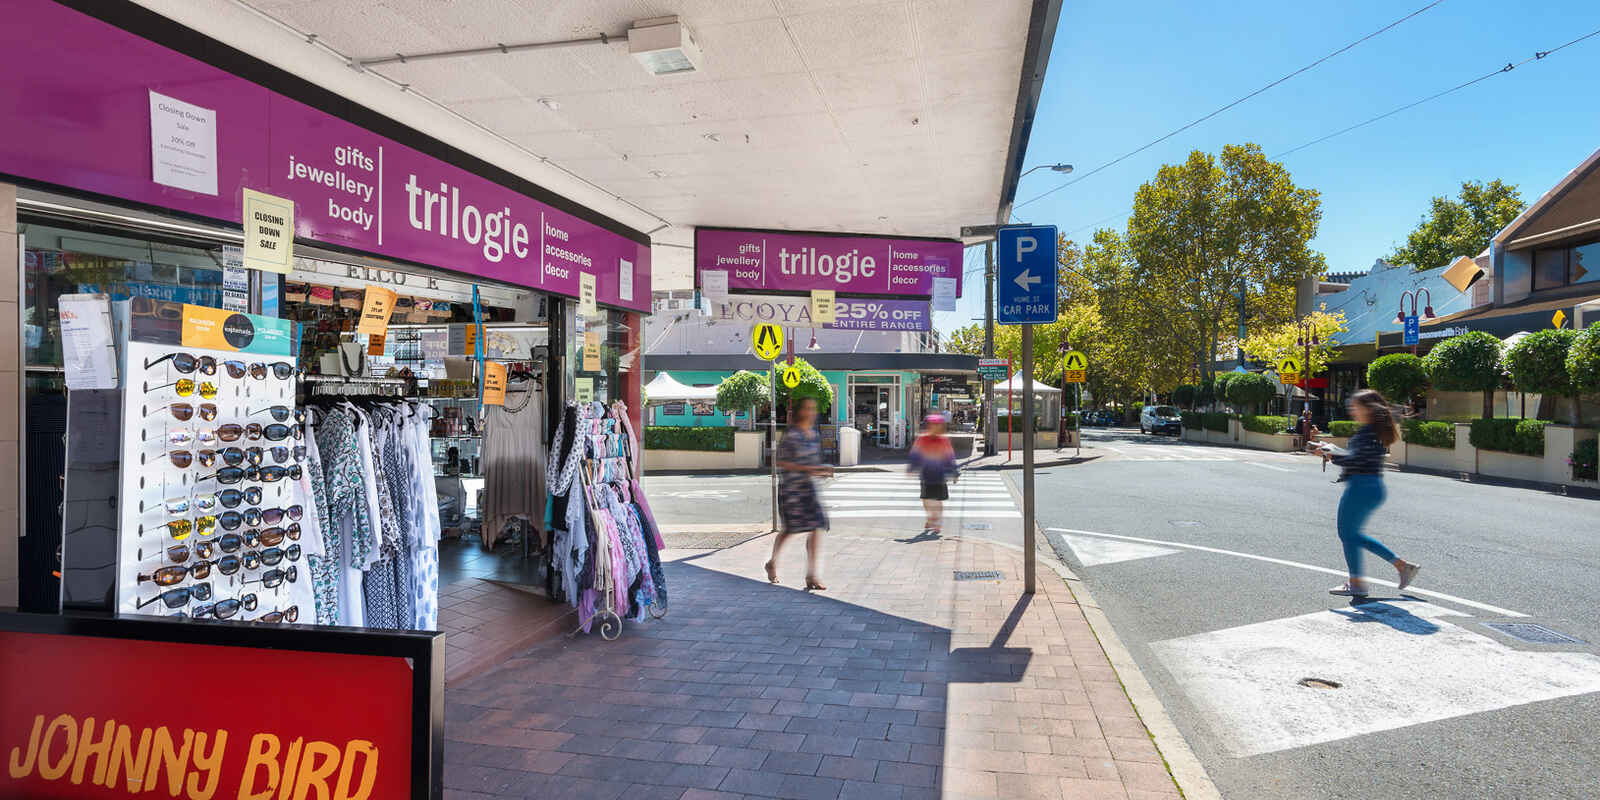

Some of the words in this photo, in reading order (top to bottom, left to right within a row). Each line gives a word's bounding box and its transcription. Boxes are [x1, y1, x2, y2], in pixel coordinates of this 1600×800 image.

[158, 103, 185, 118] Closing
[185, 111, 206, 123] Down
[334, 146, 374, 171] gifts
[287, 155, 374, 203] jewellery
[254, 211, 284, 226] CLOSING
[328, 198, 374, 231] body
[405, 174, 529, 262] trilogie
[259, 226, 281, 238] DOWN
[545, 222, 569, 242] home
[259, 239, 277, 250] SALE
[739, 243, 761, 254] gifts
[1016, 237, 1038, 262] P
[545, 244, 592, 268] accessories
[716, 255, 760, 267] jewellery
[893, 250, 919, 260] home
[545, 263, 570, 280] decor
[779, 248, 876, 283] trilogie
[892, 263, 946, 273] accessories
[736, 269, 760, 281] body
[892, 275, 919, 285] decor
[720, 302, 813, 324] ECOYA
[835, 302, 889, 319] 25%
[891, 310, 922, 321] OFF
[1003, 305, 1022, 315] CAR
[1026, 304, 1050, 315] PARK
[832, 319, 877, 329] ENTIRE
[881, 321, 923, 330] RANGE
[1408, 318, 1415, 328] P
[1069, 371, 1082, 379] 25
[8, 713, 229, 800] JOHNNY
[237, 733, 379, 800] BIRD
